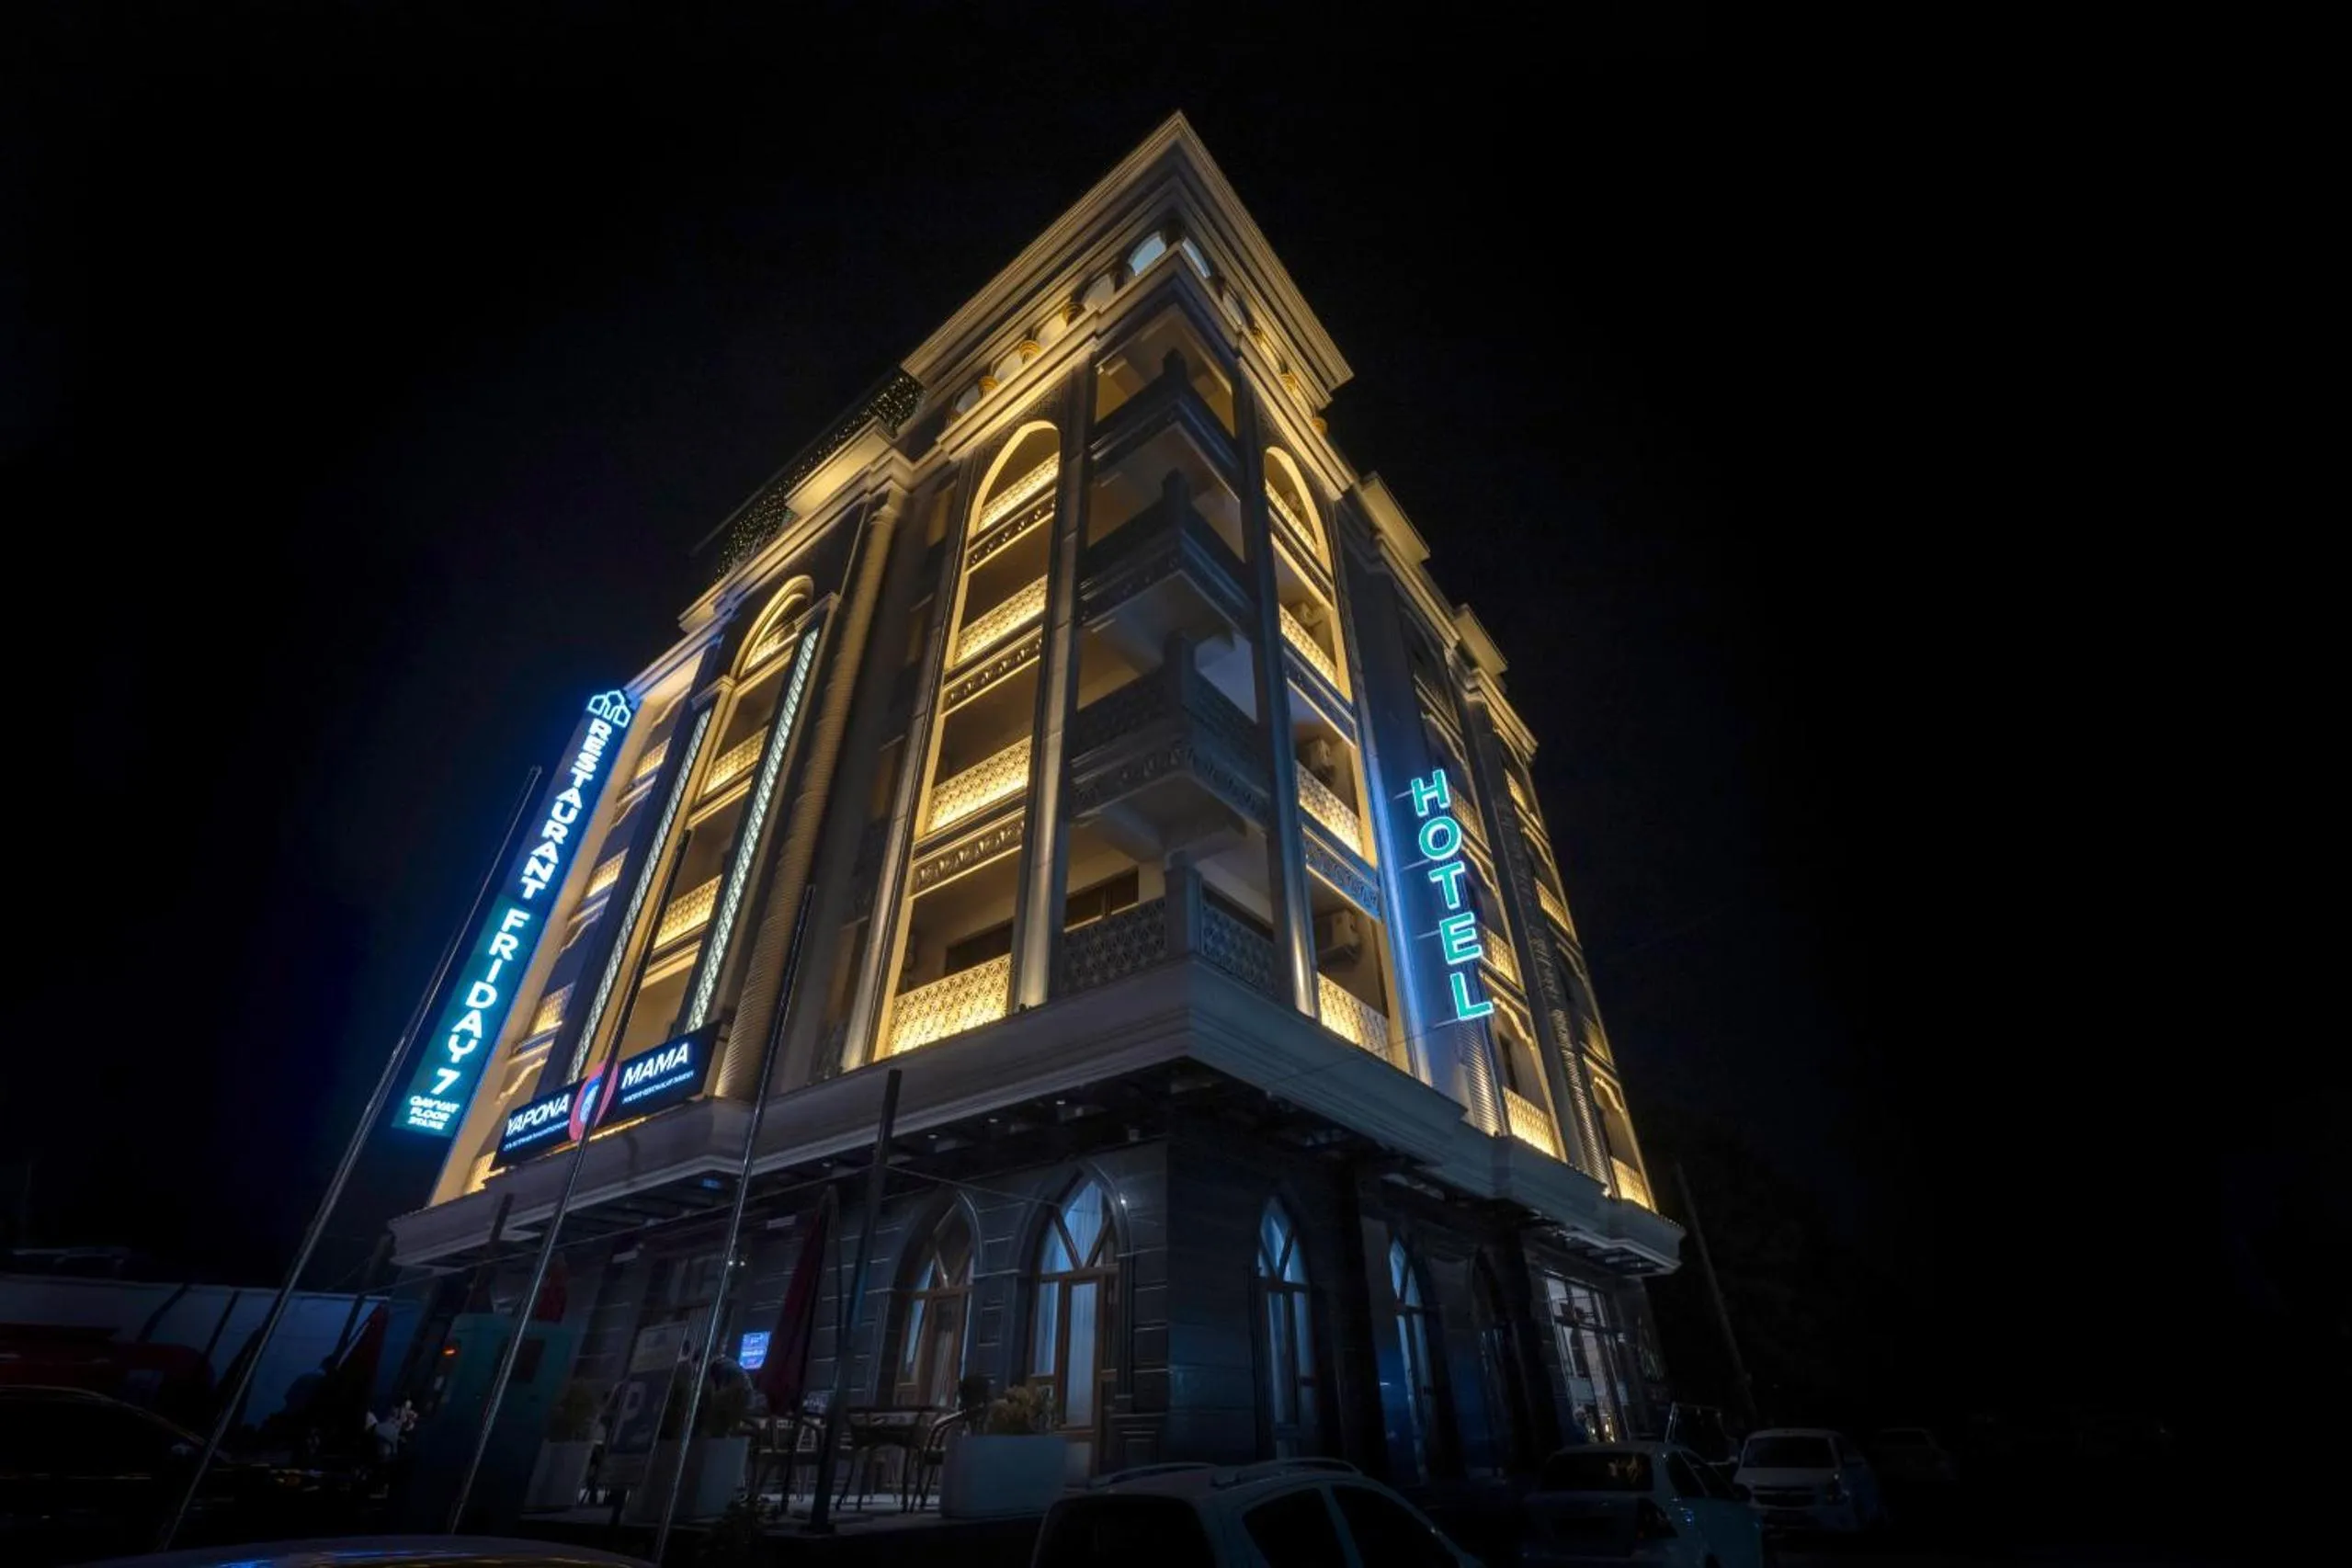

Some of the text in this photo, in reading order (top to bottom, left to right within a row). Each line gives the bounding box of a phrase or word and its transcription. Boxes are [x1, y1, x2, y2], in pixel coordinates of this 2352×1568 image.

[429, 717, 612, 1096] RESTAURANT FRIDAY 7
[1410, 768, 1494, 1021] HOTEL
[506, 1093, 571, 1137] YAPONA
[620, 1041, 689, 1090] MAMA
